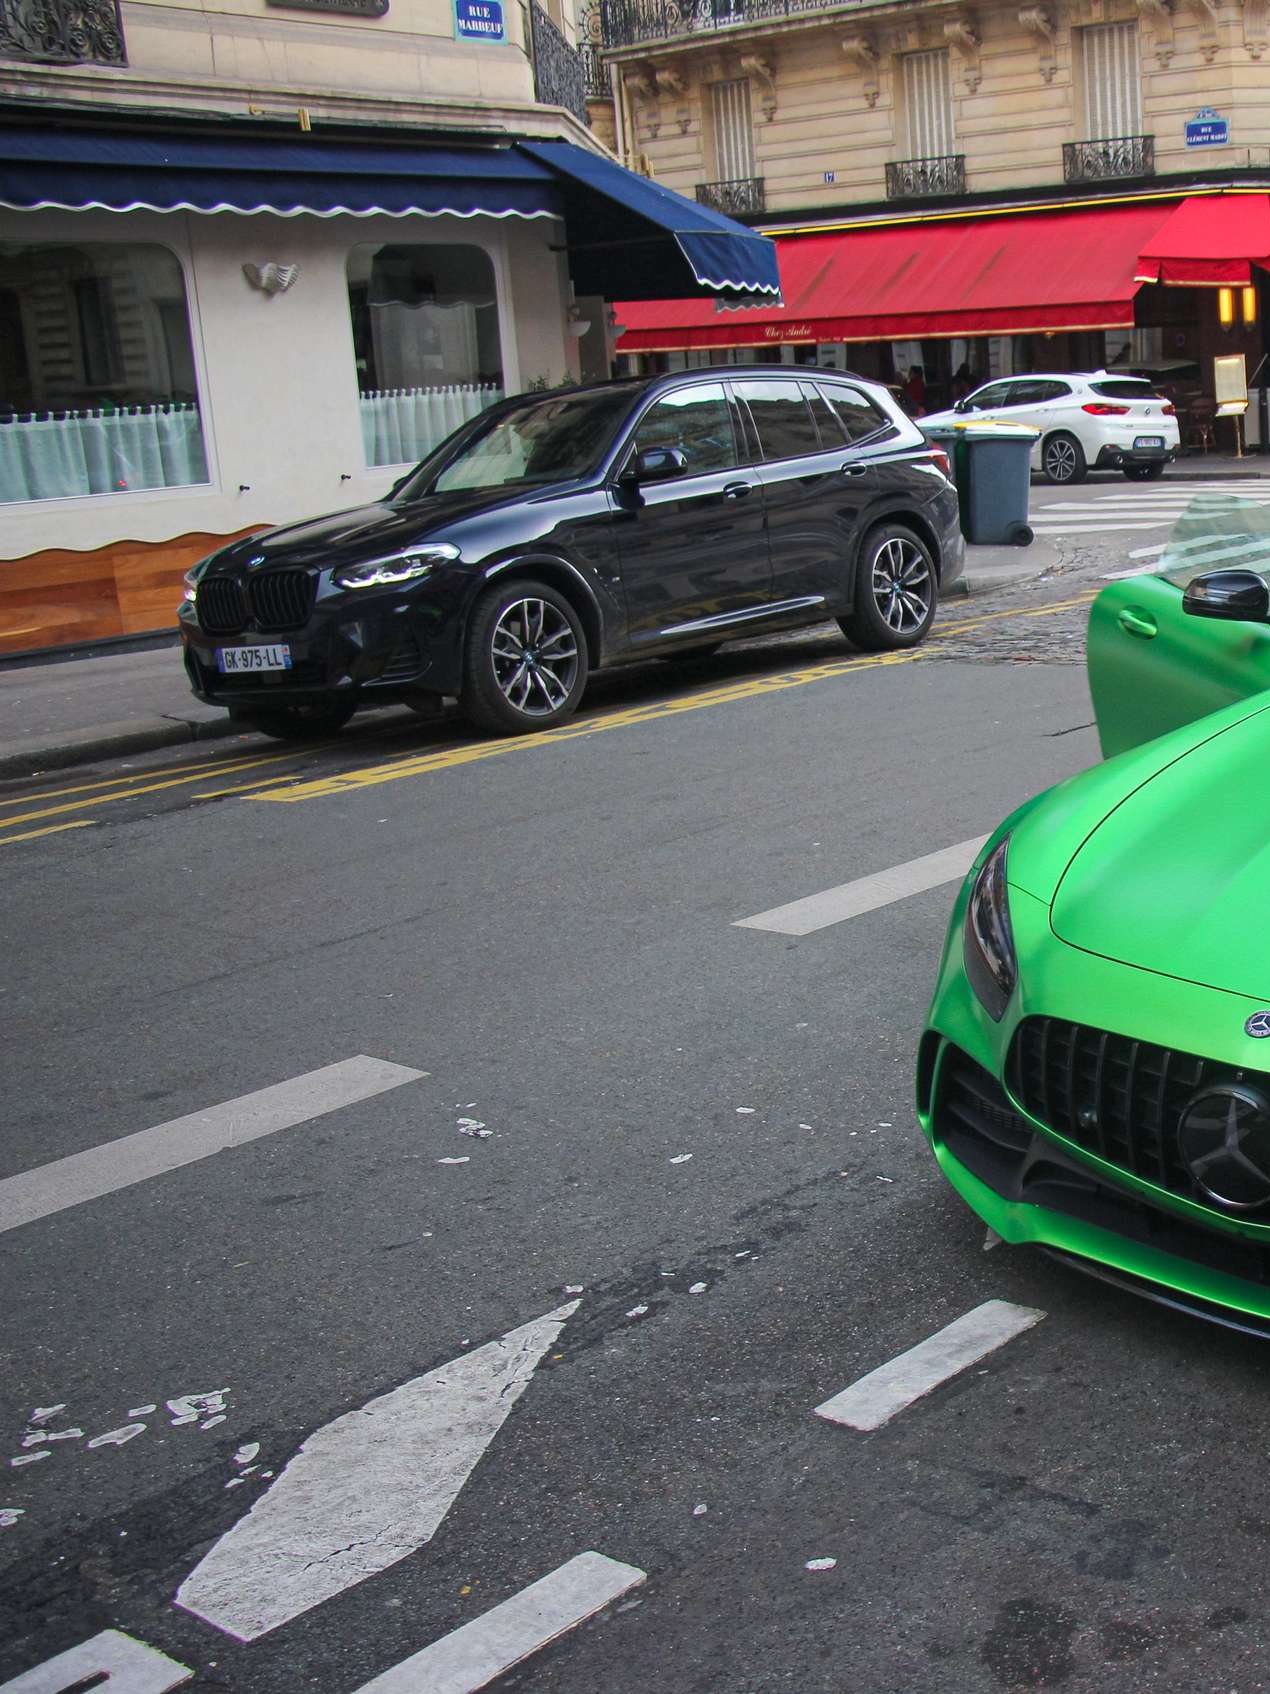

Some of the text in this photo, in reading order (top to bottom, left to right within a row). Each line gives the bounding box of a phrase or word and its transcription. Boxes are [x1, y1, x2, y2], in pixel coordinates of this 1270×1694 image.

[469, 5, 491, 18] RUE
[458, 18, 503, 34] MARBEUF
[765, 325, 812, 339] Chez André
[225, 648, 282, 669] GK-975-LL
